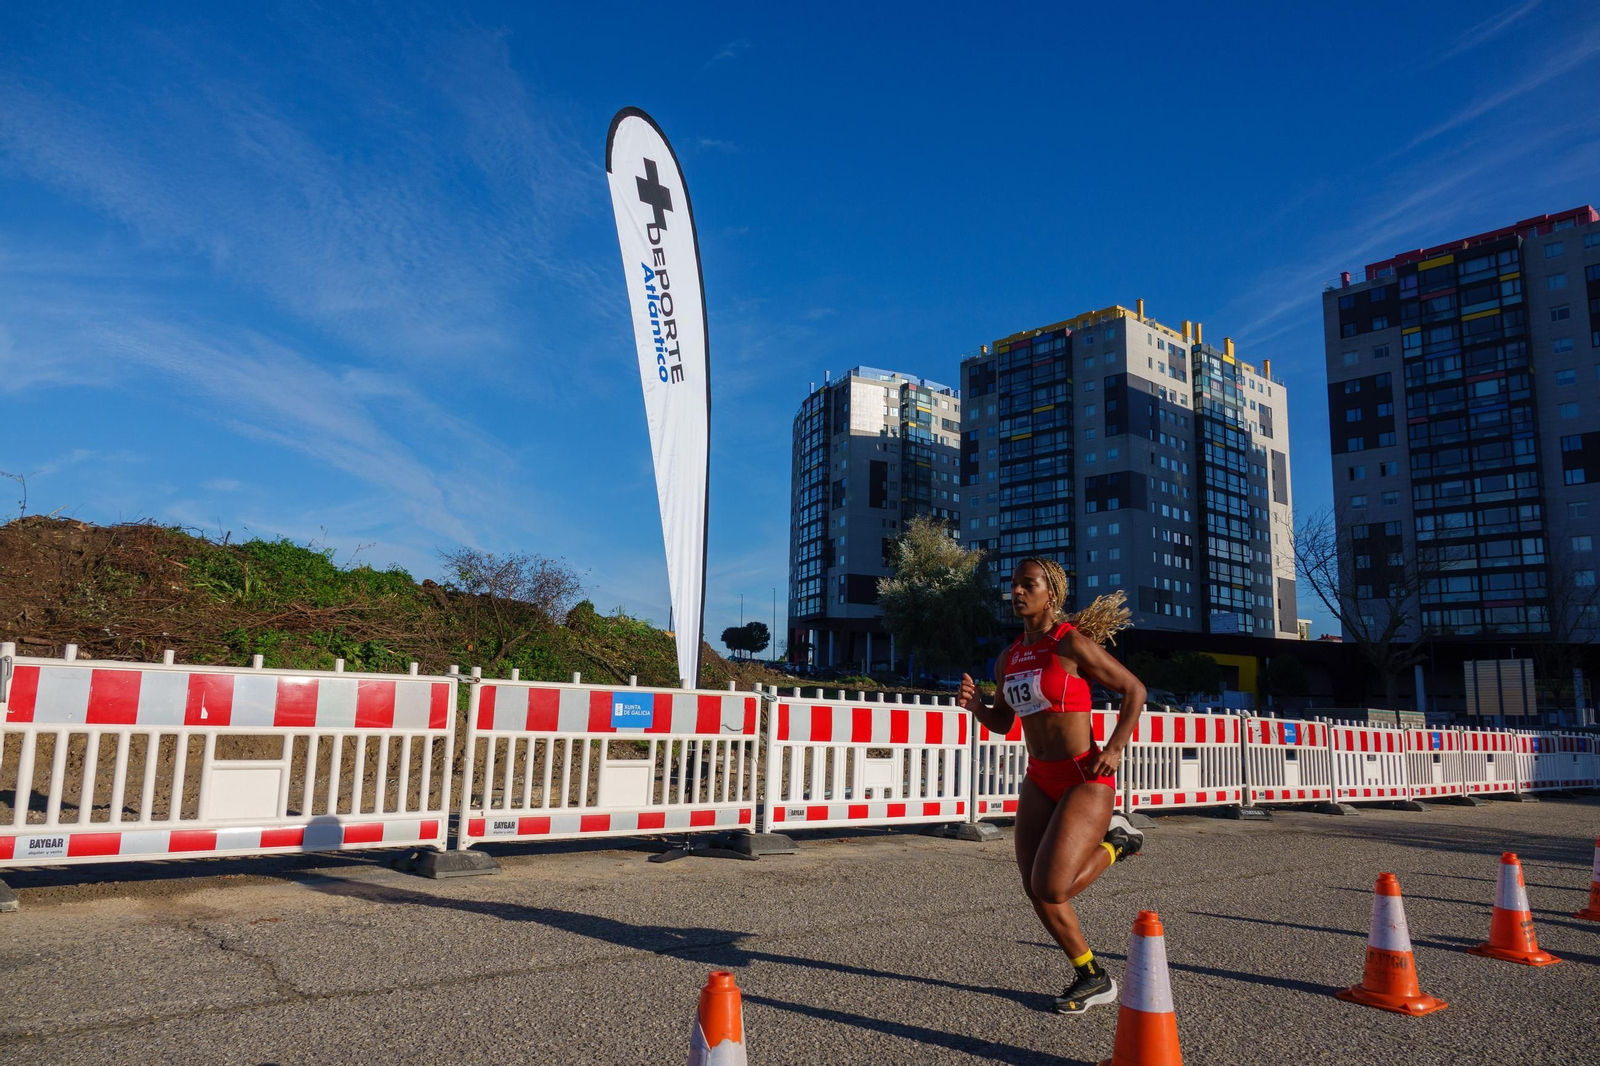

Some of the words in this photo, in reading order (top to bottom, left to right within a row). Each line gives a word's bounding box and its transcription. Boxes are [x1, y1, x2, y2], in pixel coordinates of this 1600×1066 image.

[646, 223, 685, 384] DEPORTE
[641, 261, 669, 383] Atlántico
[1007, 682, 1032, 705] 113
[493, 821, 516, 829] BAYGAR
[29, 838, 64, 849] BAYGAR
